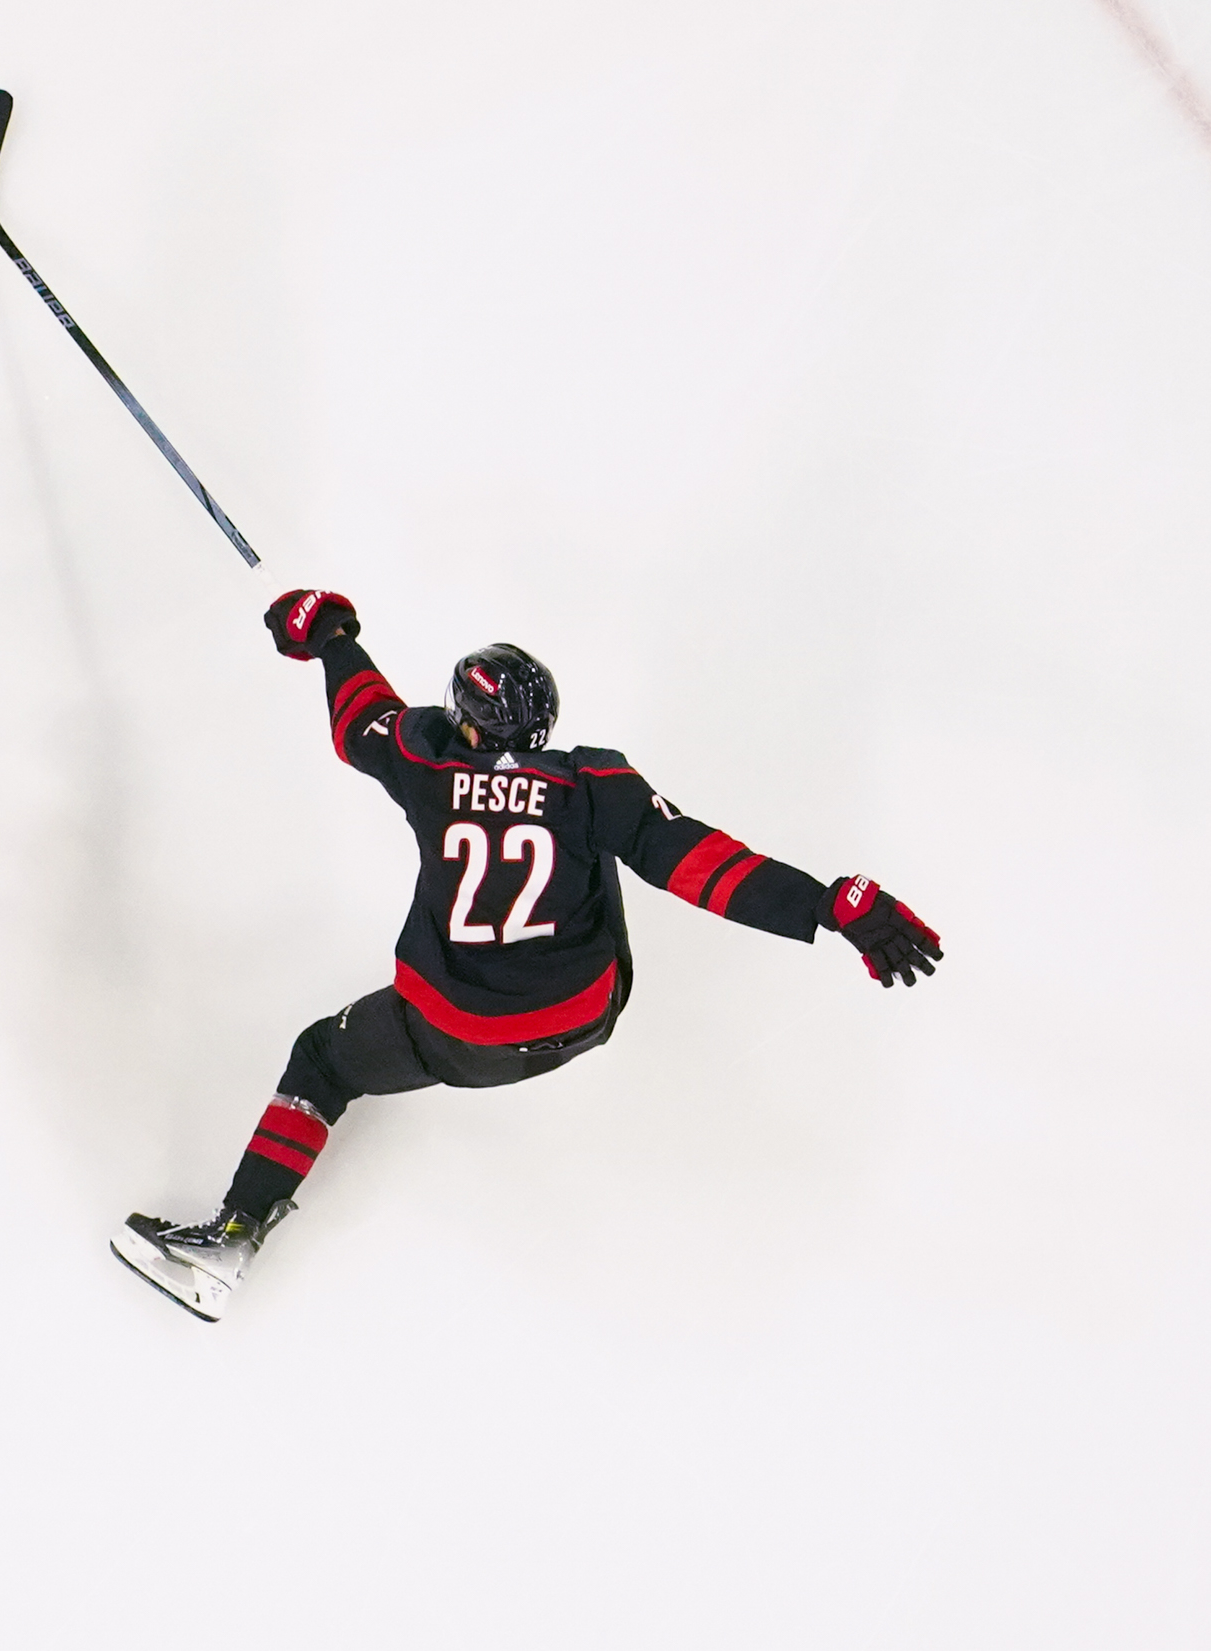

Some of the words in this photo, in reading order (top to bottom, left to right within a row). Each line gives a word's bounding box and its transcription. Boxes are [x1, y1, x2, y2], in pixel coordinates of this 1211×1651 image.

[471, 668, 495, 693] Lenovo
[529, 728, 547, 749] 22
[493, 762, 519, 771] adidas
[452, 772, 548, 816] PESCE
[442, 821, 557, 945] 22
